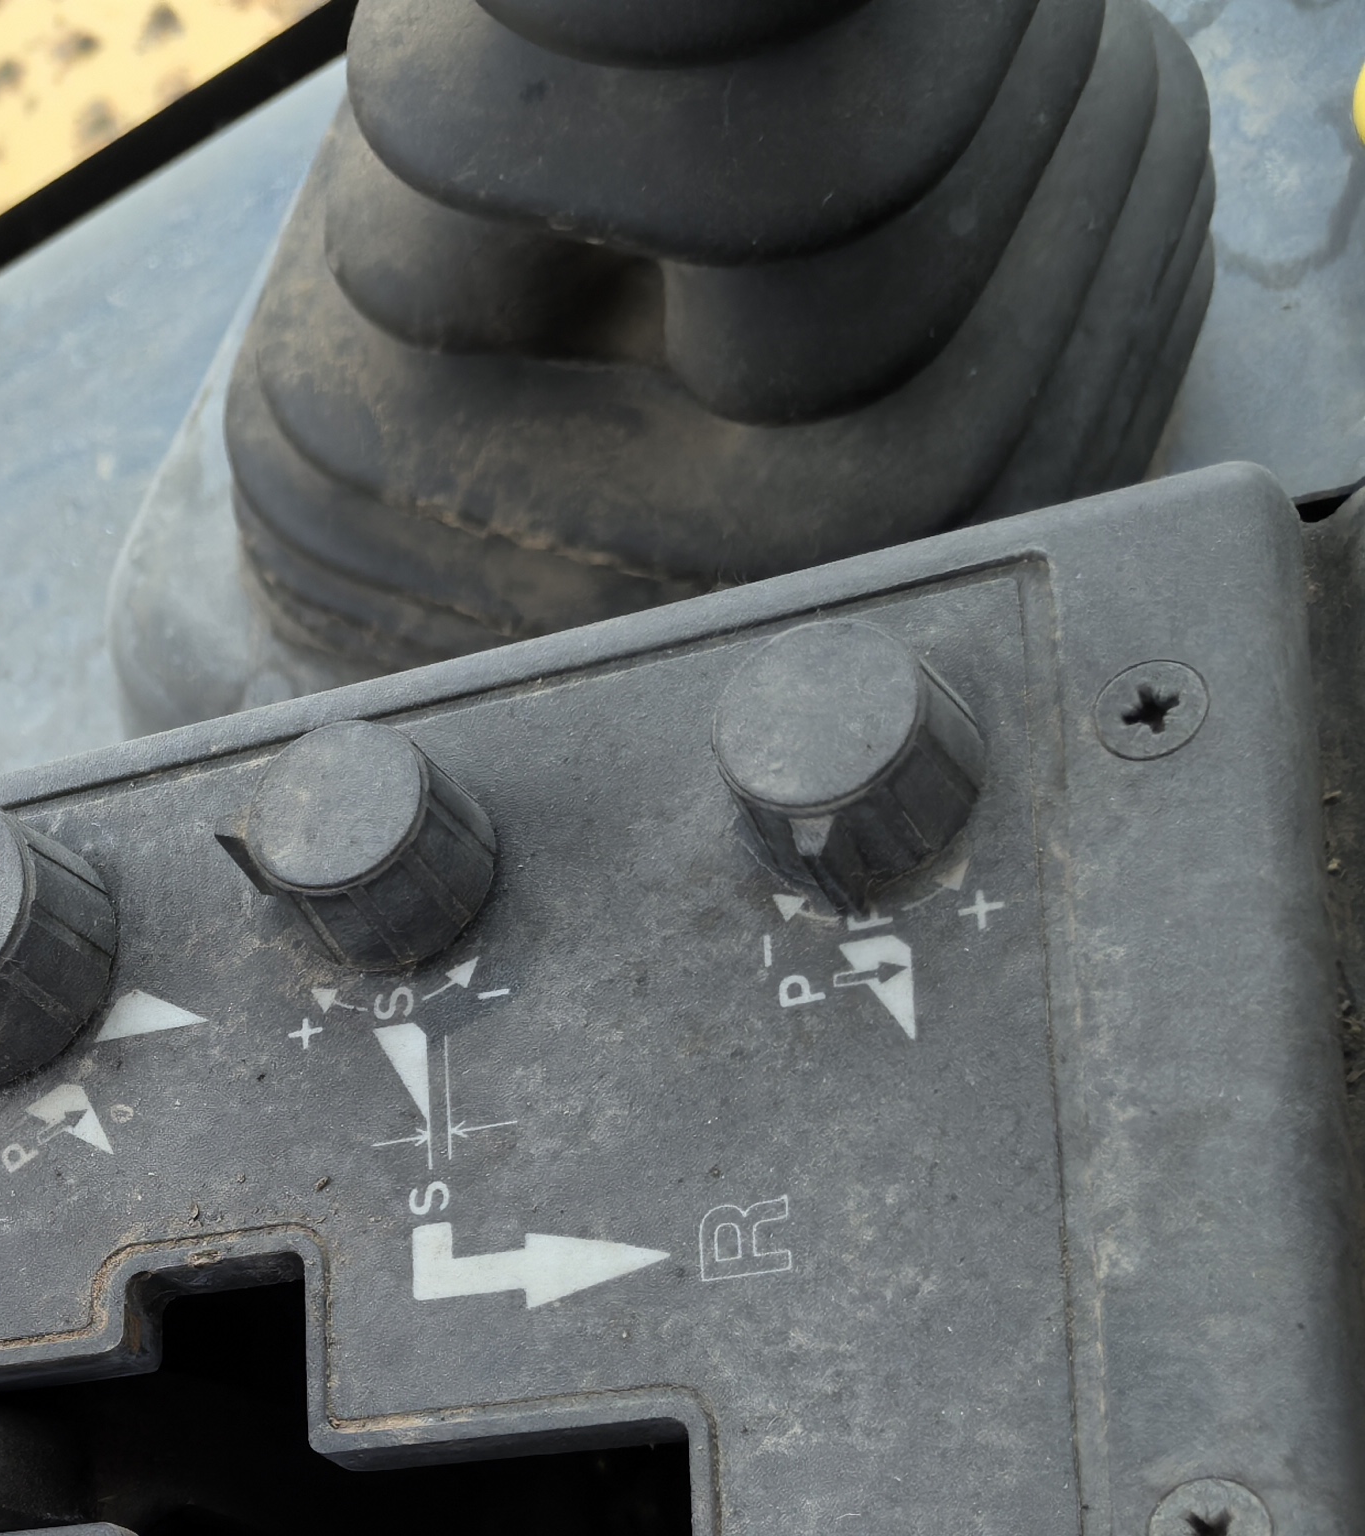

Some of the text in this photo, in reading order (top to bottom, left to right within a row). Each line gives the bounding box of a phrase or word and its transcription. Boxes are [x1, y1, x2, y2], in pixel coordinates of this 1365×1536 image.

[373, 985, 414, 1020] S
[778, 974, 827, 1008] P
[1, 1142, 39, 1174] P
[408, 1180, 450, 1216] S
[698, 1194, 793, 1282] R
